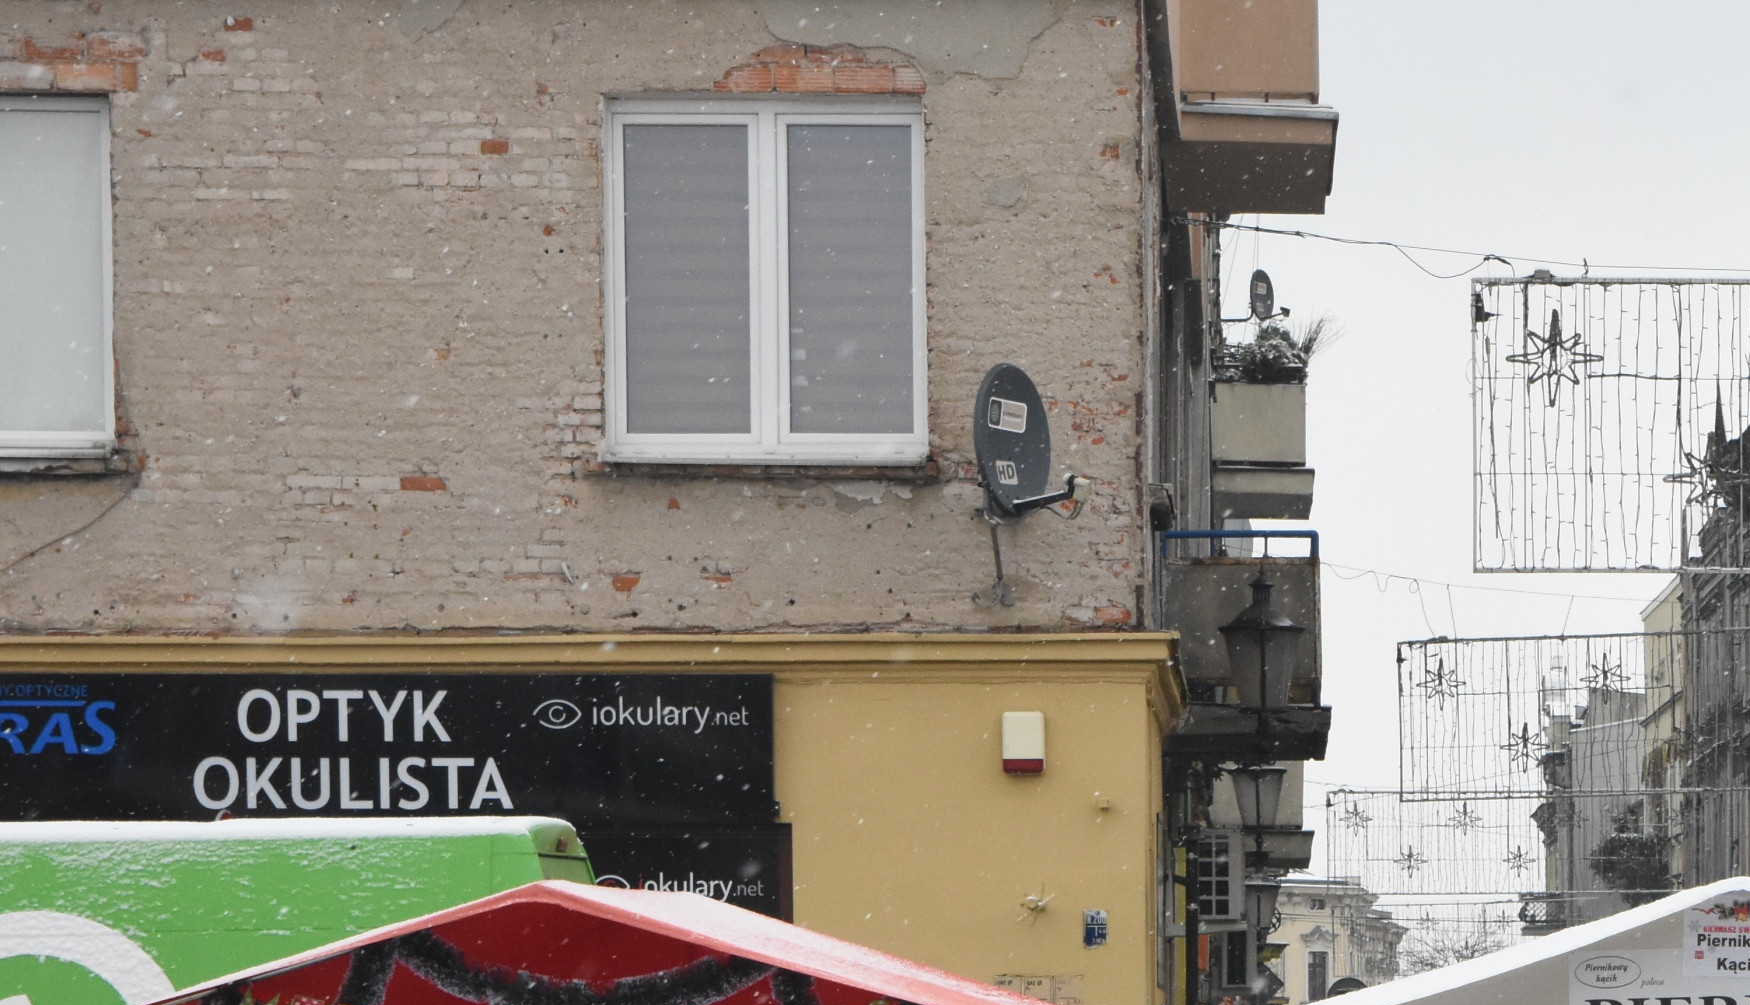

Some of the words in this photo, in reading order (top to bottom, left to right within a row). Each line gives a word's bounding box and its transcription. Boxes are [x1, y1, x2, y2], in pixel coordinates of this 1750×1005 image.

[997, 464, 1016, 481] HD
[15, 684, 88, 697] OPTYCZNE
[237, 688, 451, 743] OPTYK
[592, 696, 749, 735] iokulary.net
[193, 756, 514, 810] OKULISTA
[1584, 962, 1628, 973] Piernikowy
[1595, 974, 1618, 984] kącik
[1640, 977, 1665, 989] poleca
